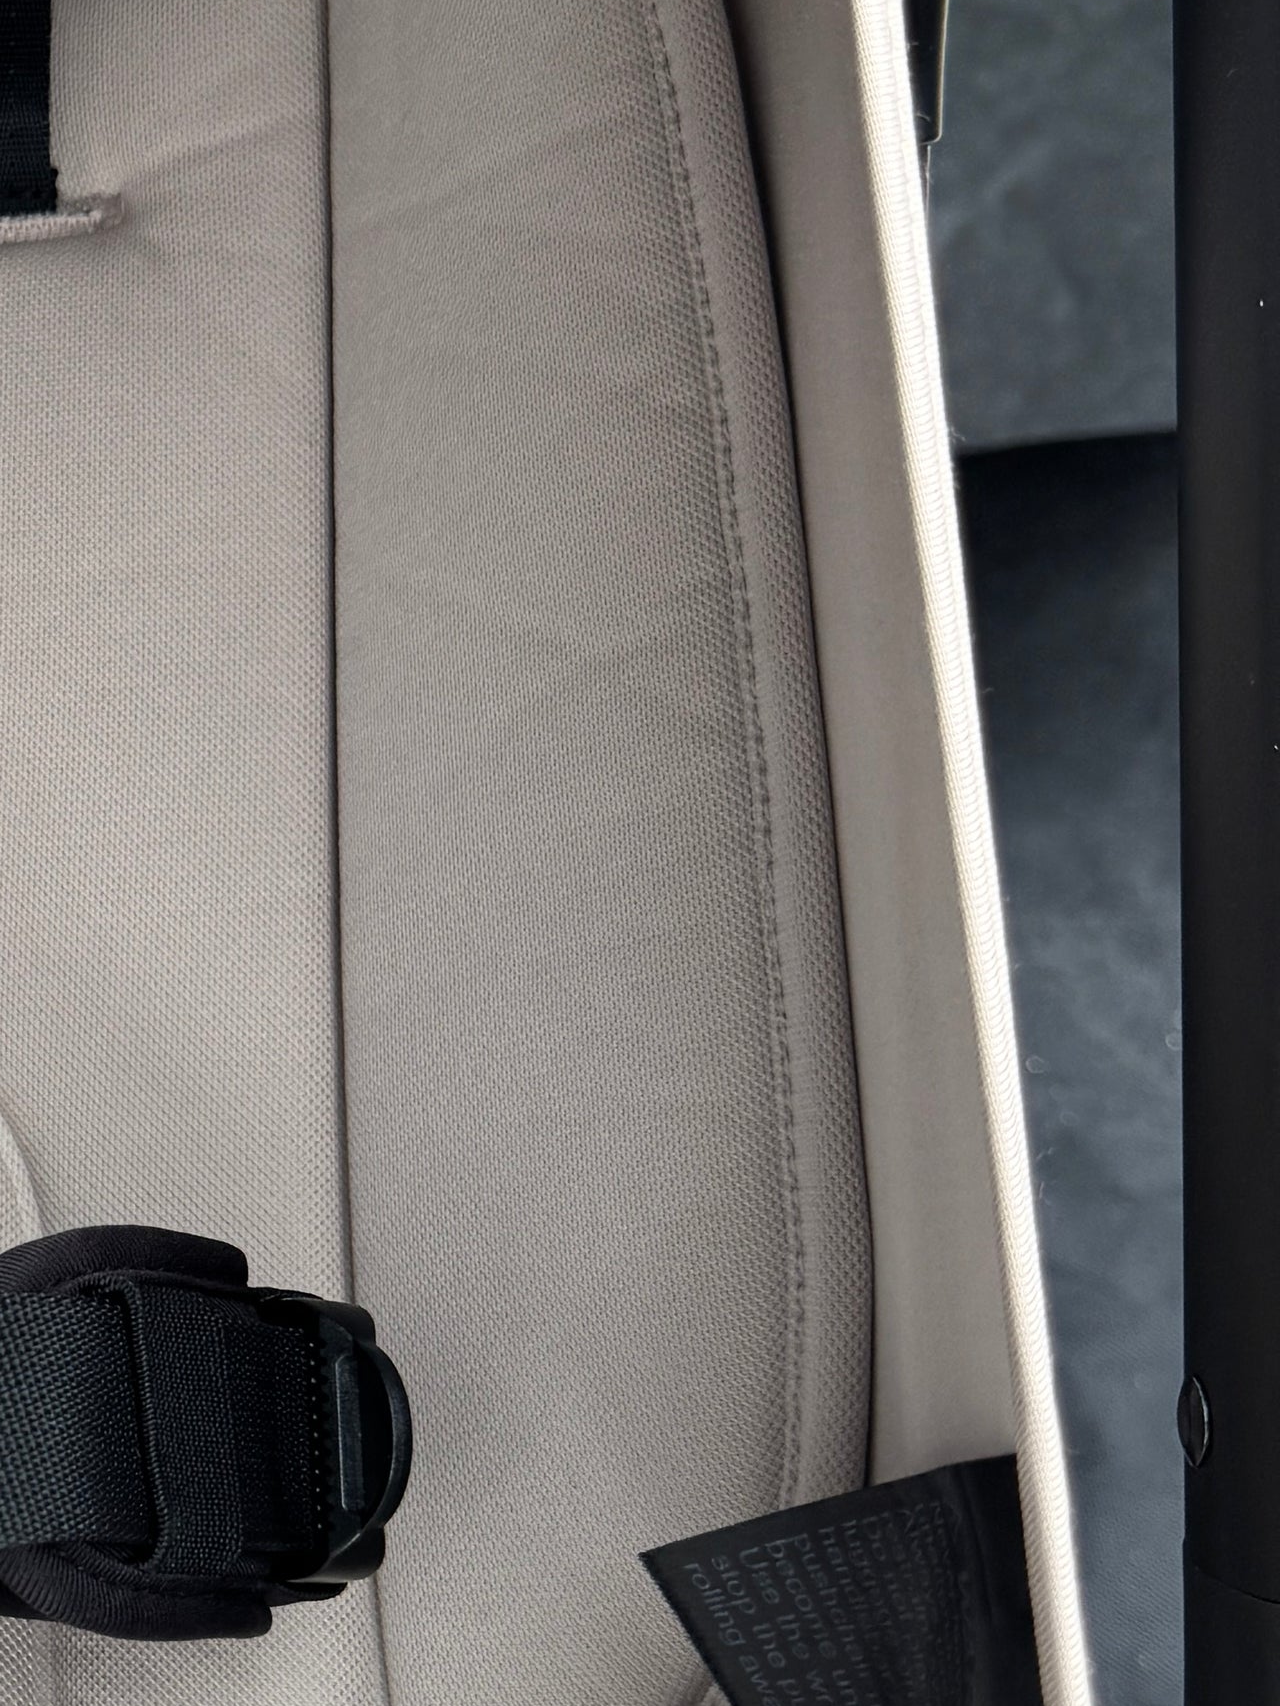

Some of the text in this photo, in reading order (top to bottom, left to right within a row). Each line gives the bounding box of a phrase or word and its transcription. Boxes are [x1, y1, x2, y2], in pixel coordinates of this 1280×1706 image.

[683, 1563, 747, 1645] rolling
[711, 1555, 756, 1615] stop
[752, 1622, 786, 1669] the
[738, 1546, 780, 1605] Use
[775, 1613, 810, 1660] the
[765, 1539, 838, 1660] become
